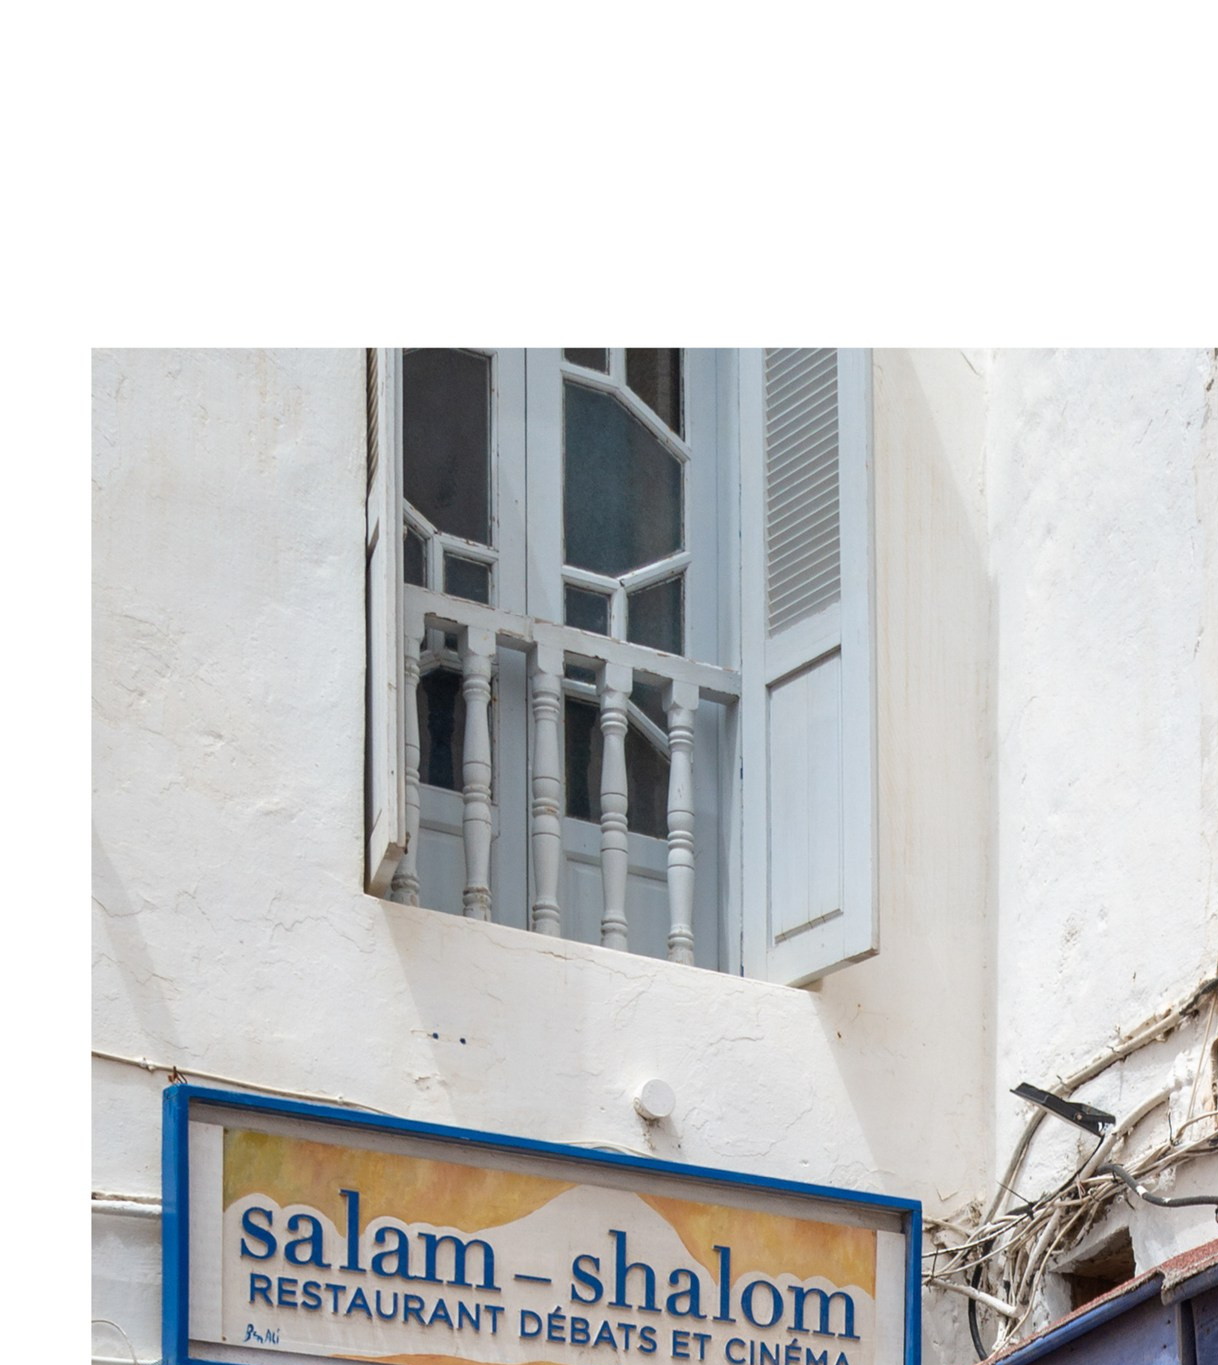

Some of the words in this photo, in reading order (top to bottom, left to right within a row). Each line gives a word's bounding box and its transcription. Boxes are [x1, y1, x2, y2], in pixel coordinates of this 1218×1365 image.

[240, 1188, 502, 1292] salam
[570, 1229, 861, 1341] shalom
[249, 1272, 505, 1335] RESTAURANT
[519, 1306, 658, 1354] DÉBATS
[671, 1329, 712, 1361] ET
